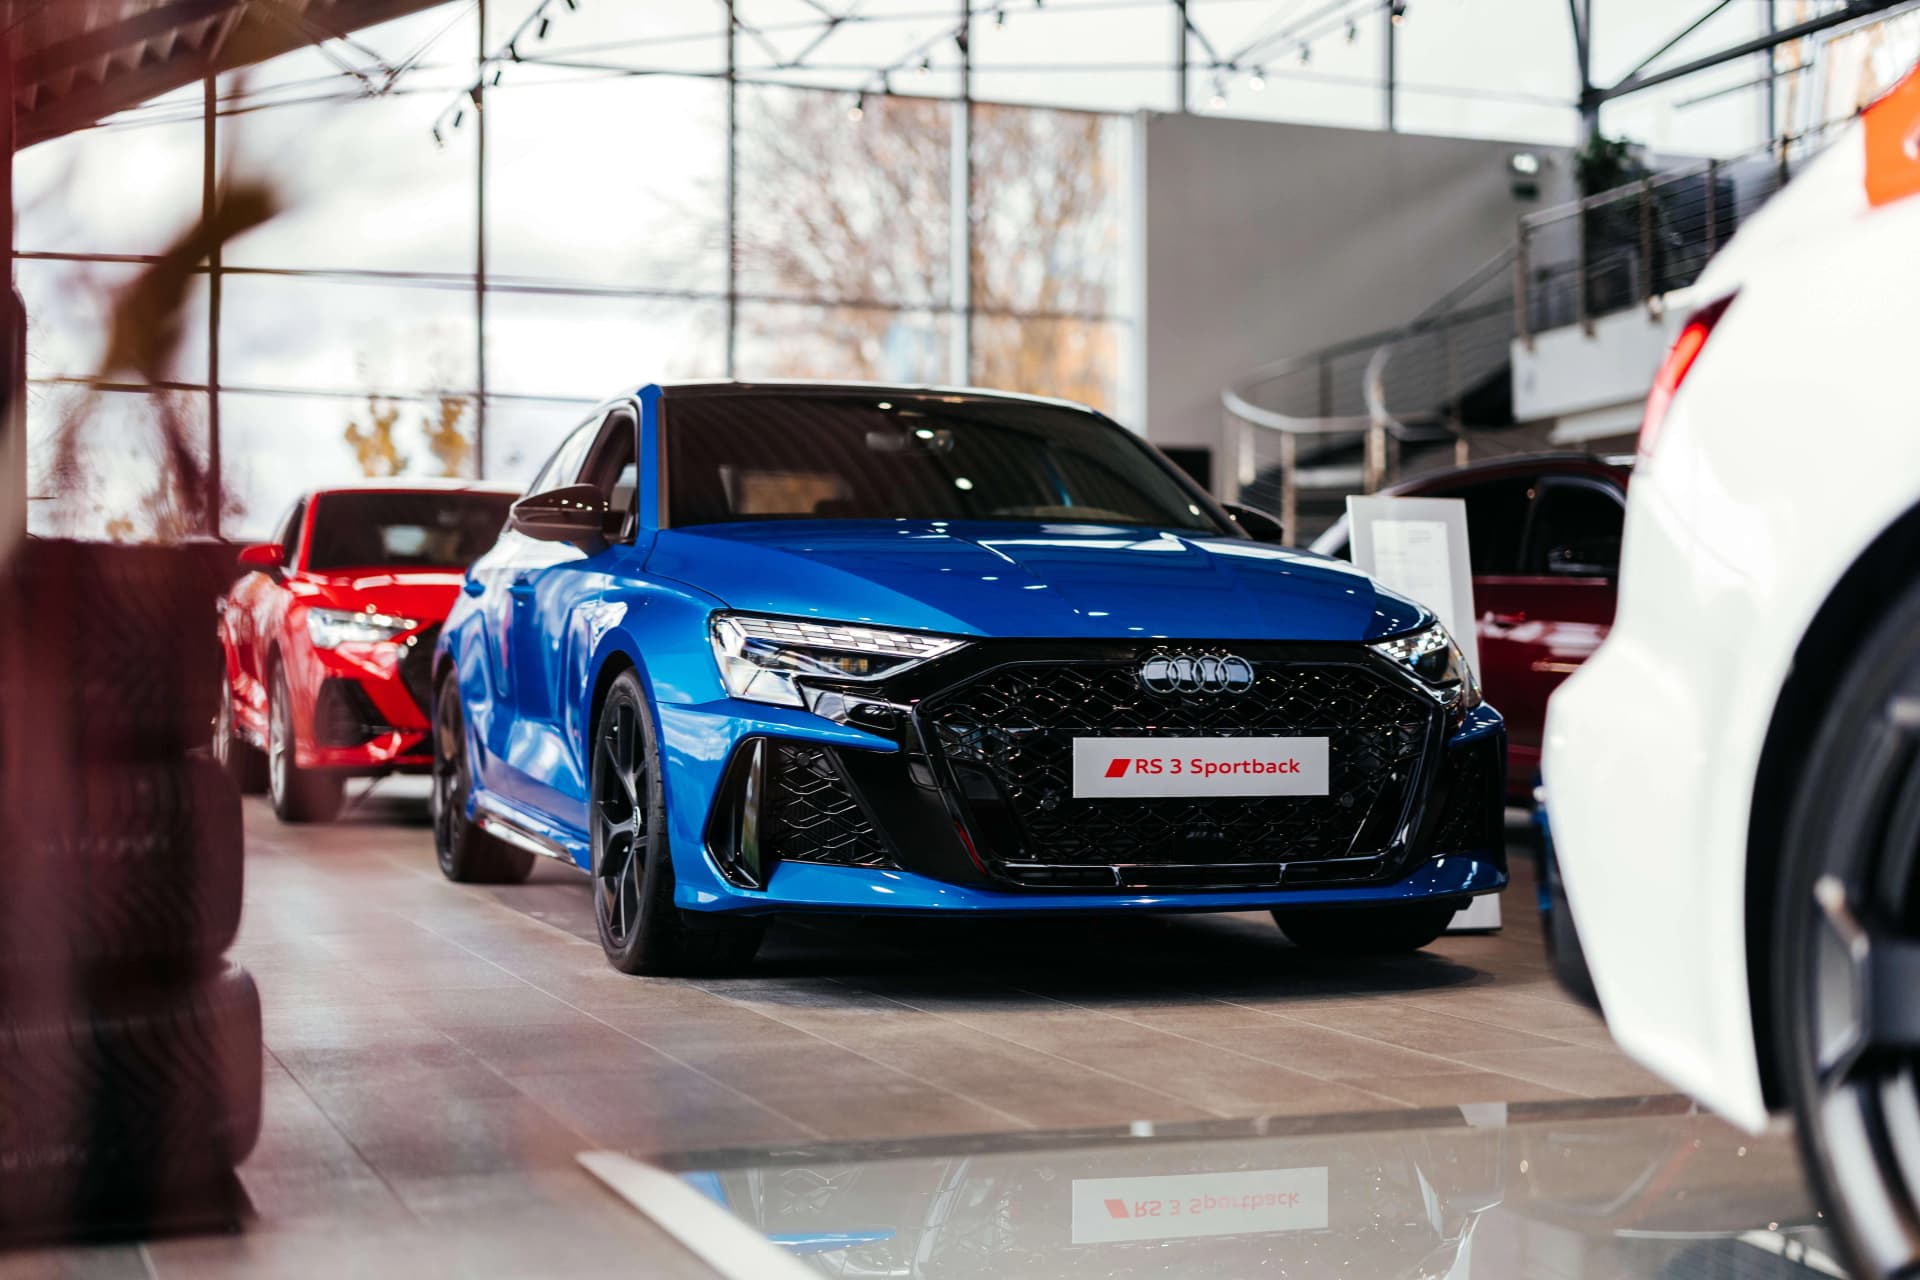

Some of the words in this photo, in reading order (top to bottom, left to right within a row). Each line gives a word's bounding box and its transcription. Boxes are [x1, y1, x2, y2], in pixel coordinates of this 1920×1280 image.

[1135, 758, 1163, 775] RS
[1170, 758, 1182, 775] 3
[1190, 758, 1301, 778] Sportback
